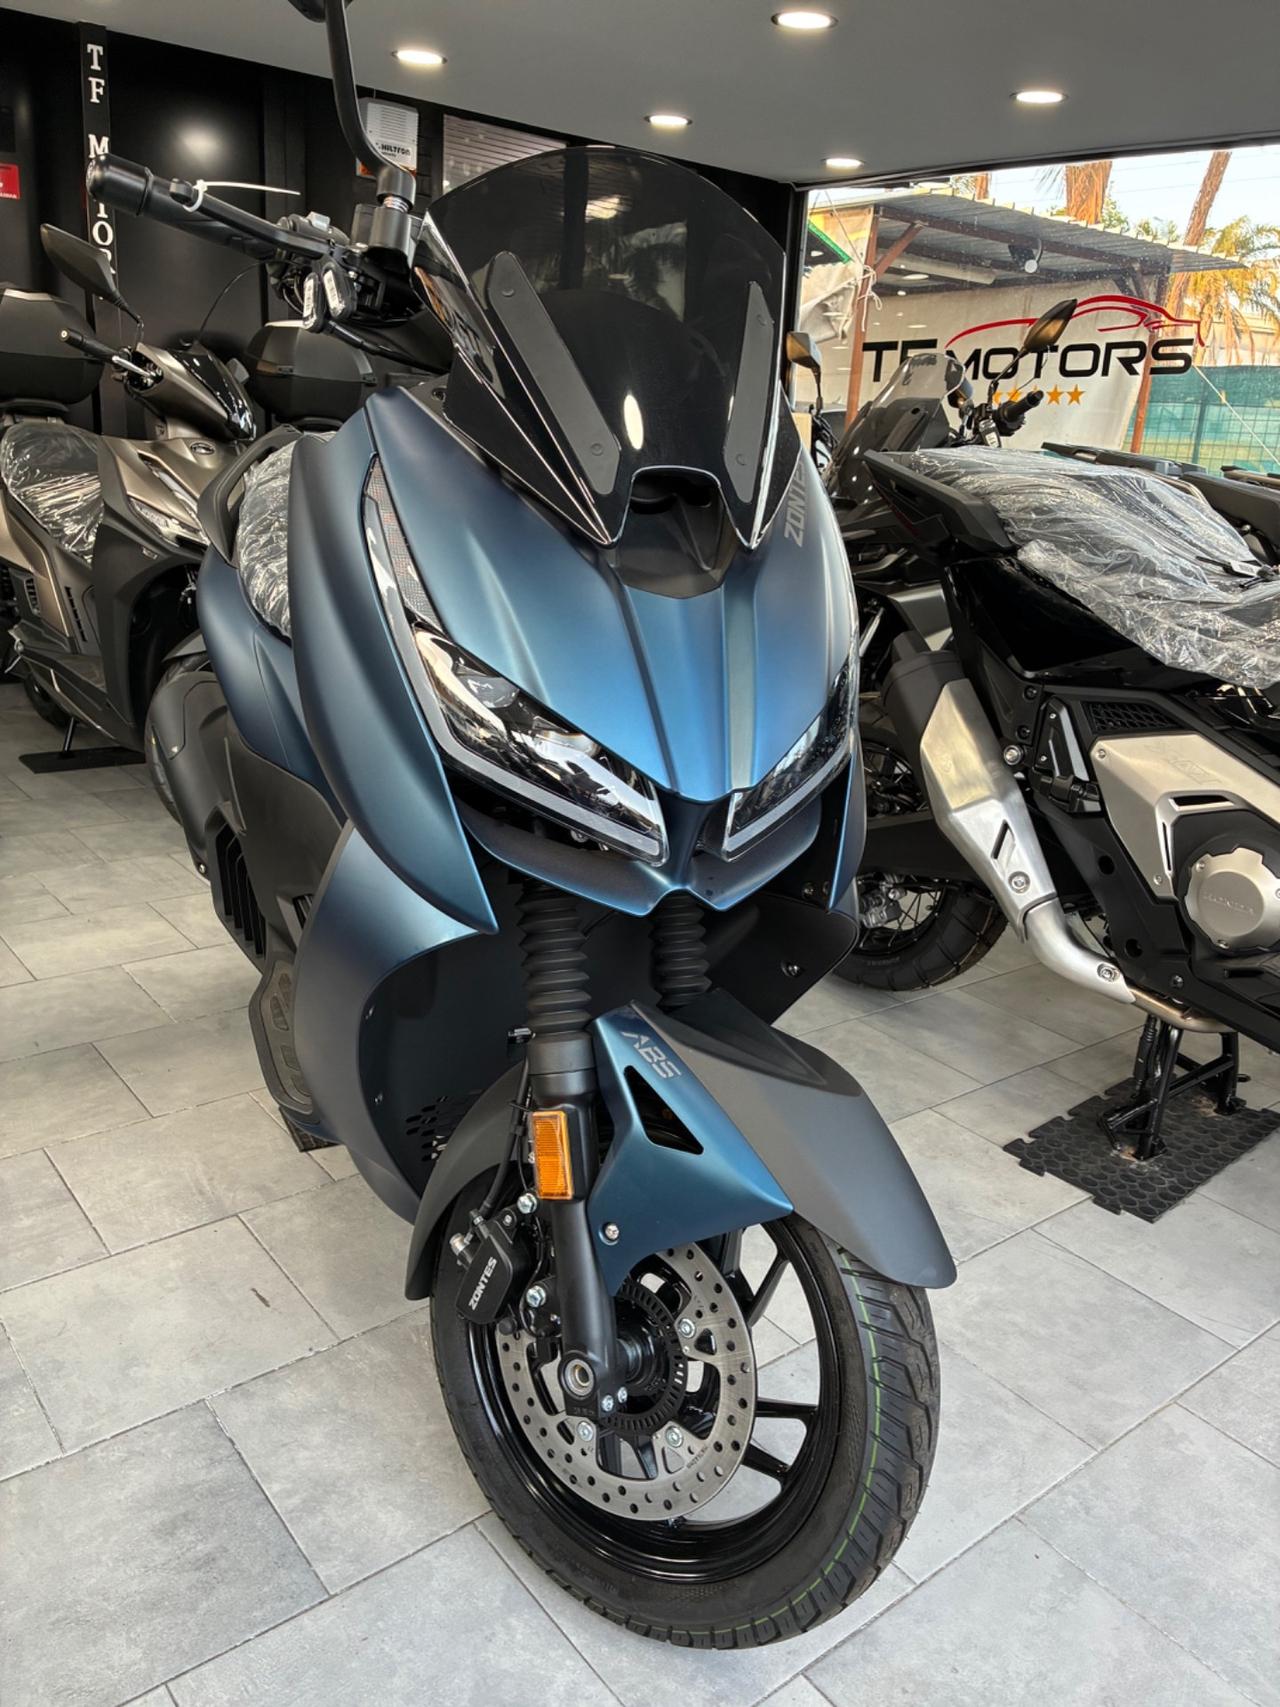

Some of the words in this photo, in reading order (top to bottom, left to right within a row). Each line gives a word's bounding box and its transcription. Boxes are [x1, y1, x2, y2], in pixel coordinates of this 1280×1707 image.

[86, 43, 105, 103] TF
[620, 1031, 682, 1079] ABS
[468, 1256, 498, 1311] ZONTES
